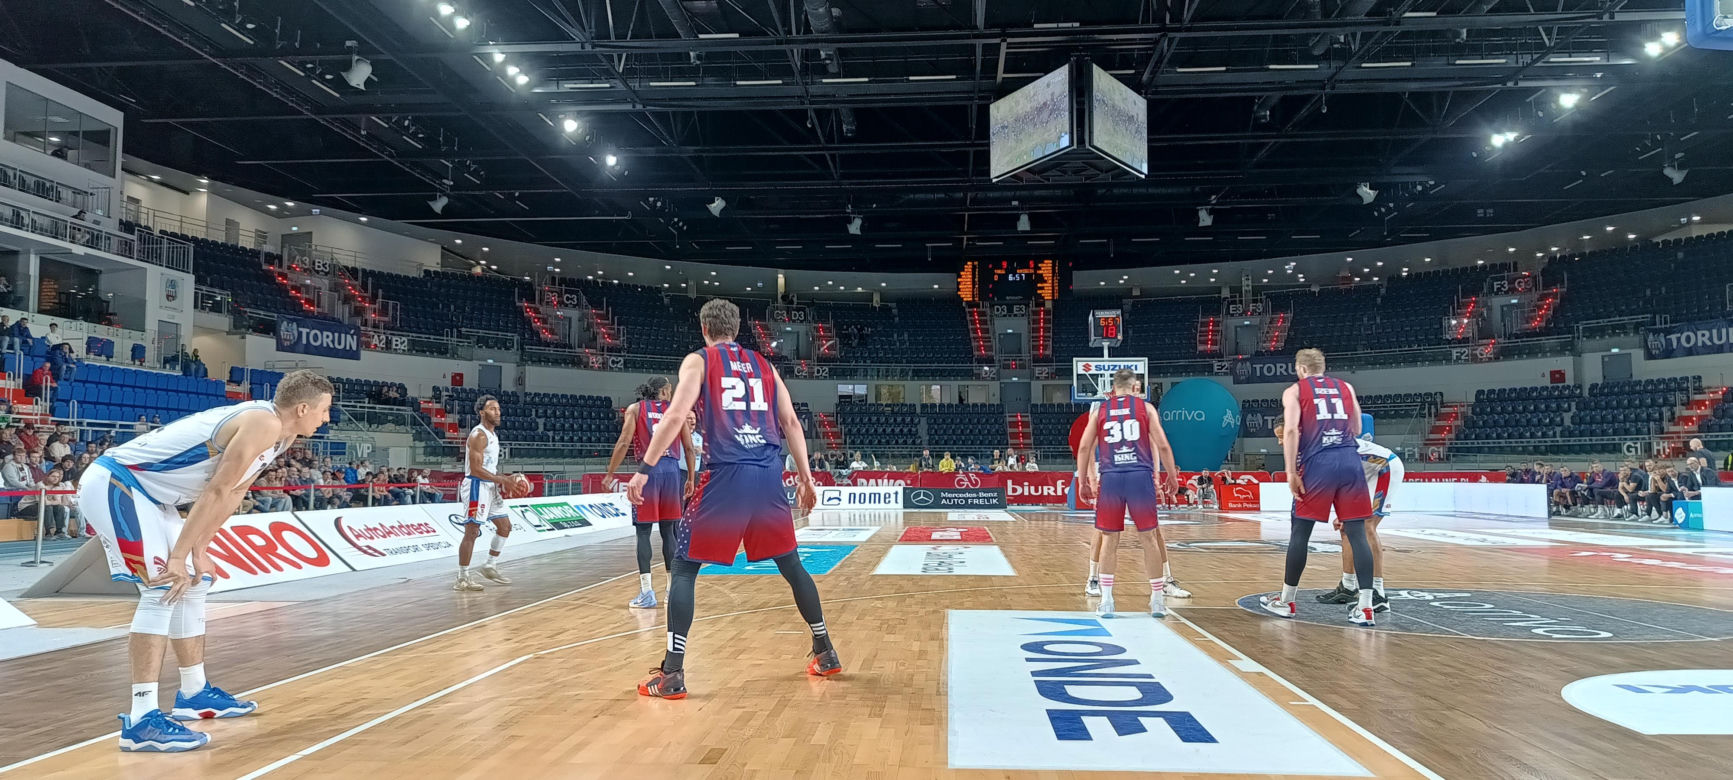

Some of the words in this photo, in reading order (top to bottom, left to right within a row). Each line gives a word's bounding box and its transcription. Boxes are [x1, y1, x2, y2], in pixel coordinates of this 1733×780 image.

[315, 260, 330, 272] B3
[1008, 273, 1025, 281] 6:57
[1493, 280, 1509, 292] F3
[1514, 277, 1533, 290] G3
[563, 294, 578, 305] C3
[774, 310, 787, 319] C3
[791, 311, 805, 320] D3
[994, 305, 1007, 314] D3
[1013, 304, 1026, 314] E3
[1229, 304, 1243, 314] E3
[1249, 303, 1263, 313] F3
[1100, 316, 1120, 326] 6:57
[1103, 325, 1117, 338] 18
[1665, 327, 1733, 349] TORU
[299, 327, 358, 351] TORUŃ
[372, 335, 386, 348] A2
[392, 337, 408, 350] B2
[1452, 349, 1469, 361] F2
[608, 357, 624, 368] C2
[729, 360, 754, 373] MEER
[1213, 362, 1228, 373] E2
[814, 367, 829, 376] D2
[1035, 367, 1049, 377] E2
[1252, 363, 1297, 377] TORU
[721, 377, 768, 411] 21
[1163, 408, 1206, 421] arriva
[1313, 398, 1348, 420] 11
[1103, 419, 1140, 443] 30
[356, 443, 372, 458] VIP
[1623, 441, 1641, 456] G1
[1653, 441, 1669, 455] H1
[1114, 452, 1137, 461] KING
[848, 490, 900, 505] nomet
[940, 491, 998, 499] Mercedes-Benz
[347, 520, 437, 541] AutoAndreas
[1020, 640, 1220, 743] ONDE
